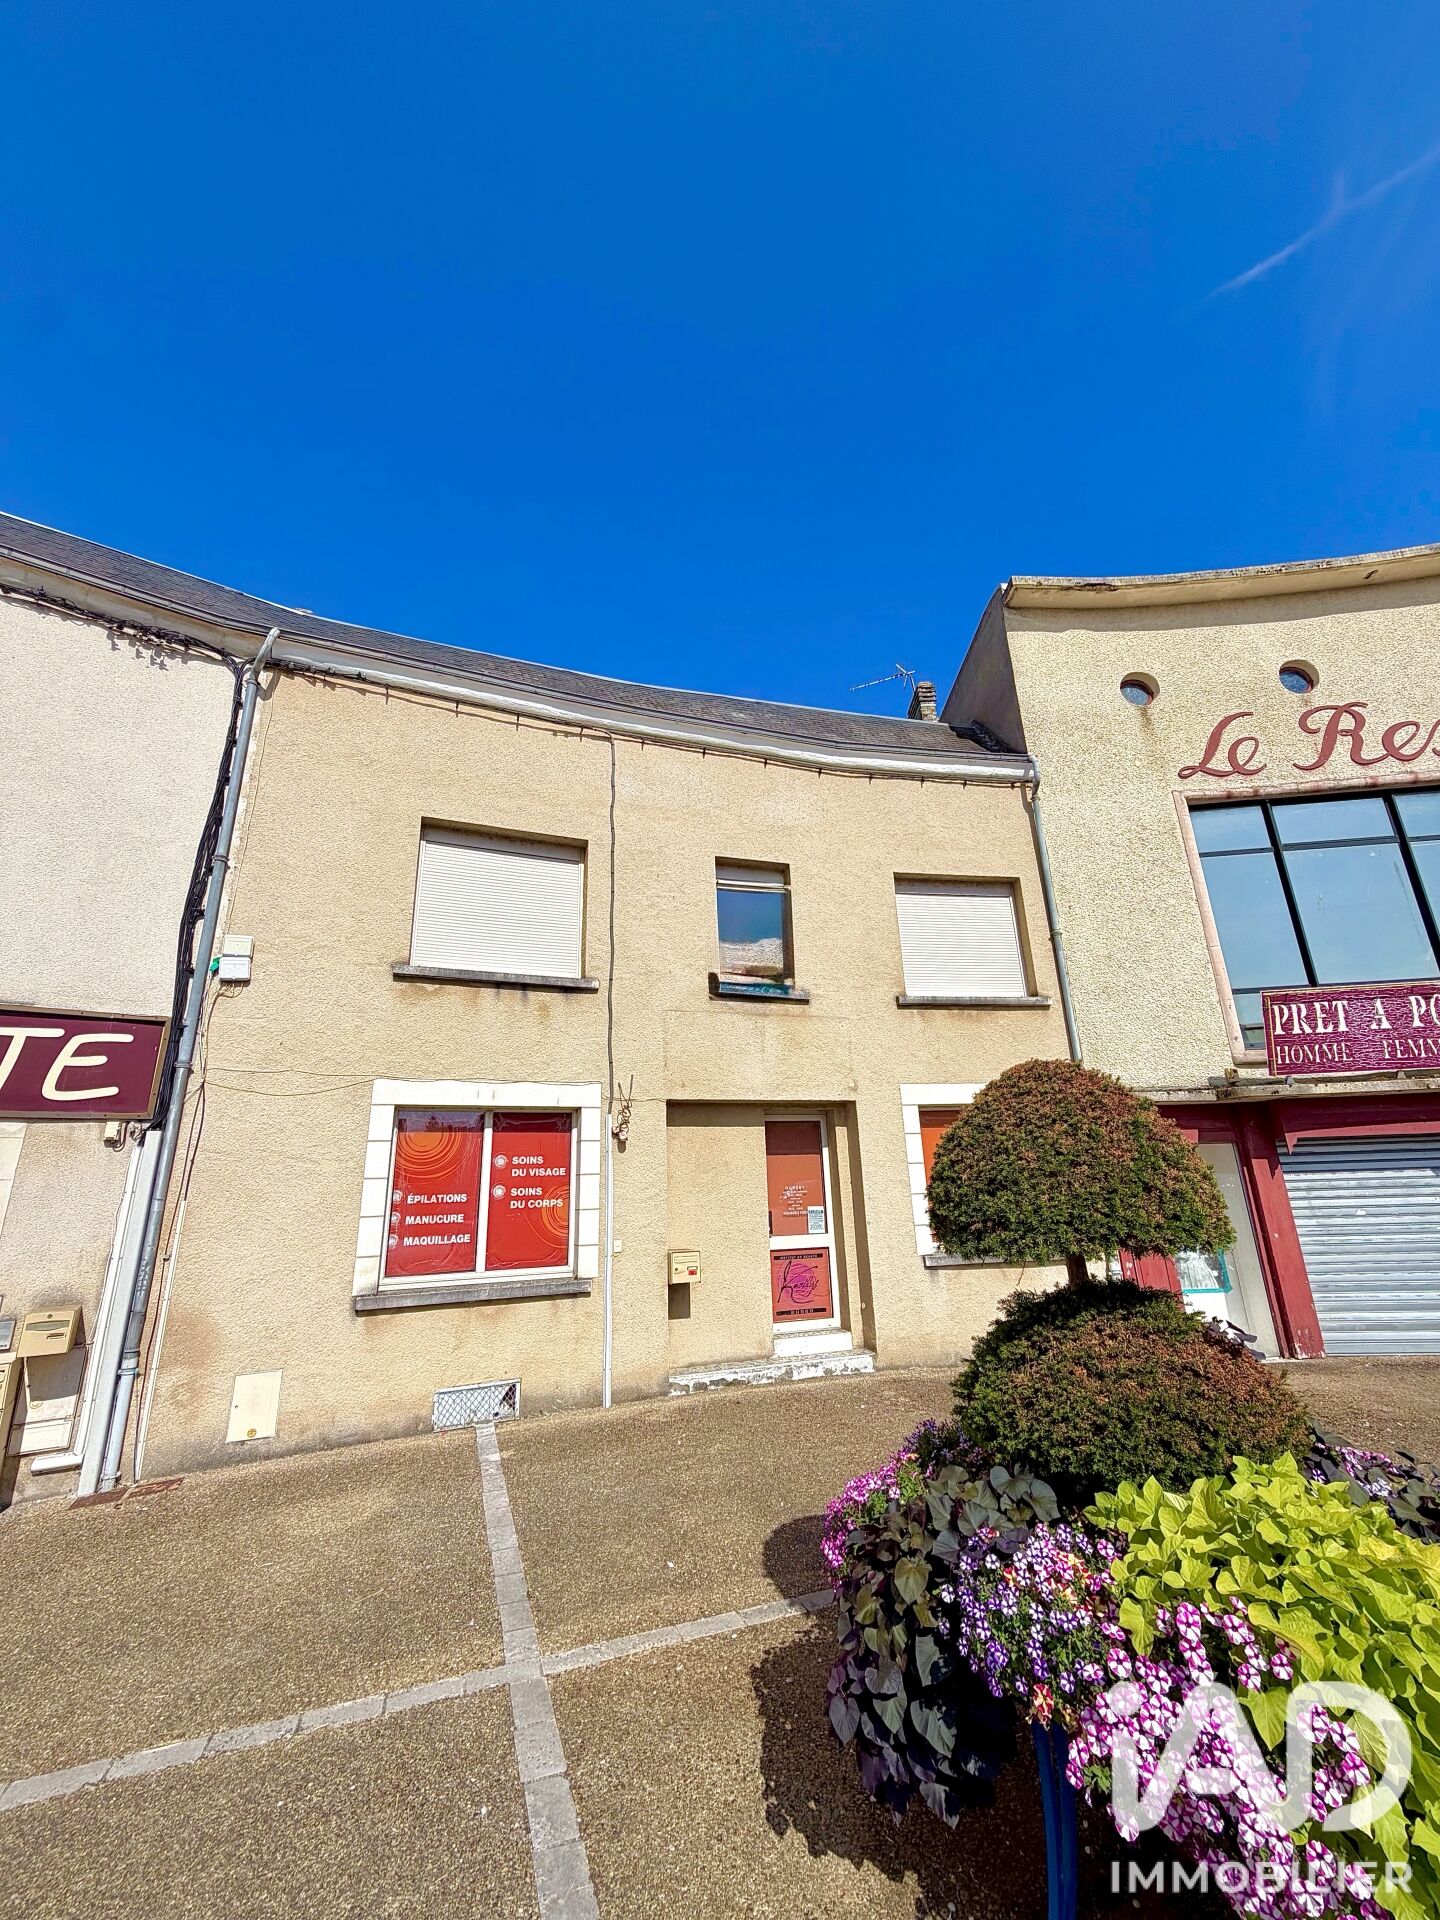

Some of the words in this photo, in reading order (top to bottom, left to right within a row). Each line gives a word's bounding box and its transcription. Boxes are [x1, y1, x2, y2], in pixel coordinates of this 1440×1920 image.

[1178, 711, 1267, 779] Le
[1293, 702, 1440, 772] Re
[1272, 1000, 1349, 1035] PRET
[1370, 998, 1392, 1029] A
[1276, 1042, 1353, 1064] HOMME
[0, 1027, 134, 1101] TE
[511, 1156, 544, 1165] SOINS
[511, 1168, 527, 1177] DU
[529, 1167, 567, 1176] VISAGE
[510, 1187, 543, 1196] SOINS
[407, 1193, 468, 1205] ÉPILATIONS
[510, 1200, 525, 1209] DU
[527, 1199, 564, 1208] CORPS
[405, 1214, 465, 1225] MANUCURE
[403, 1234, 471, 1246] MAQUILLAGE
